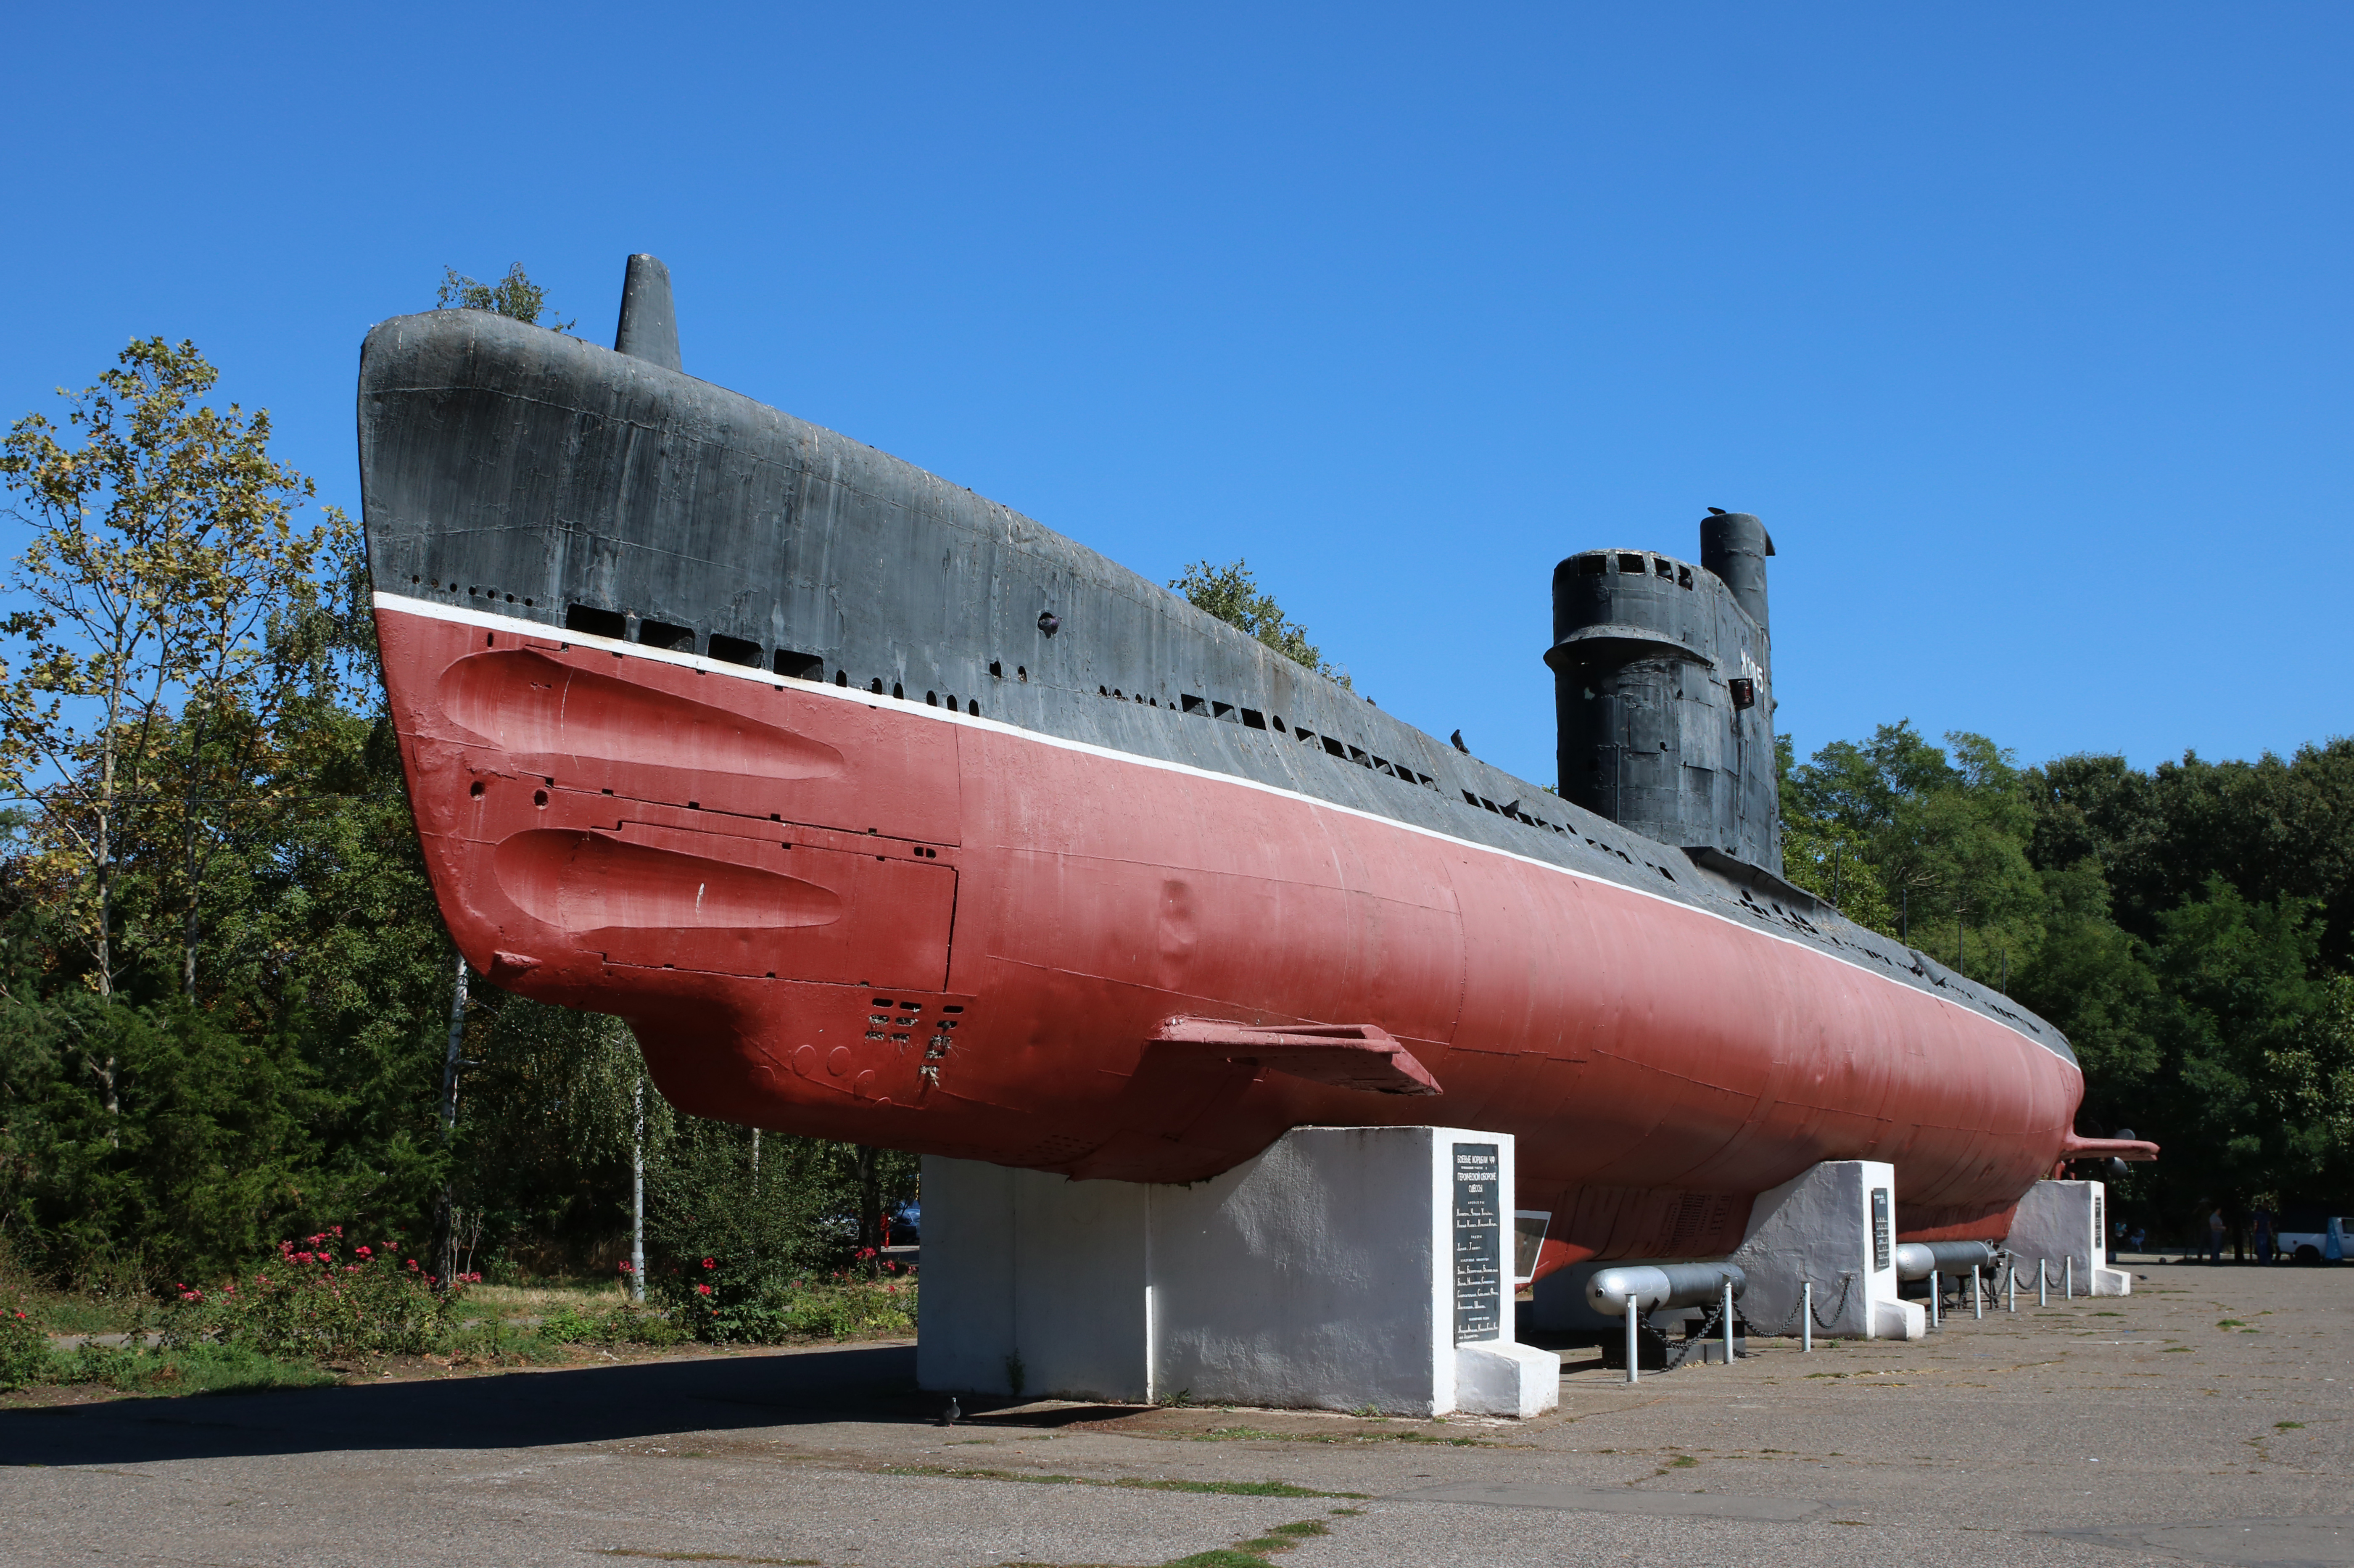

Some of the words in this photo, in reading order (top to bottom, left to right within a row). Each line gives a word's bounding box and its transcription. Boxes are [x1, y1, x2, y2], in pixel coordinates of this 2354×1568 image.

[1457, 1155, 1471, 1164] БОЕВЫЕ
[1472, 1155, 1488, 1164] КОРАБЛИ
[1457, 1171, 1480, 1181] ГЕРОИЧЕСКОЙ
[1468, 1184, 1483, 1193] ОДЕССЫ
